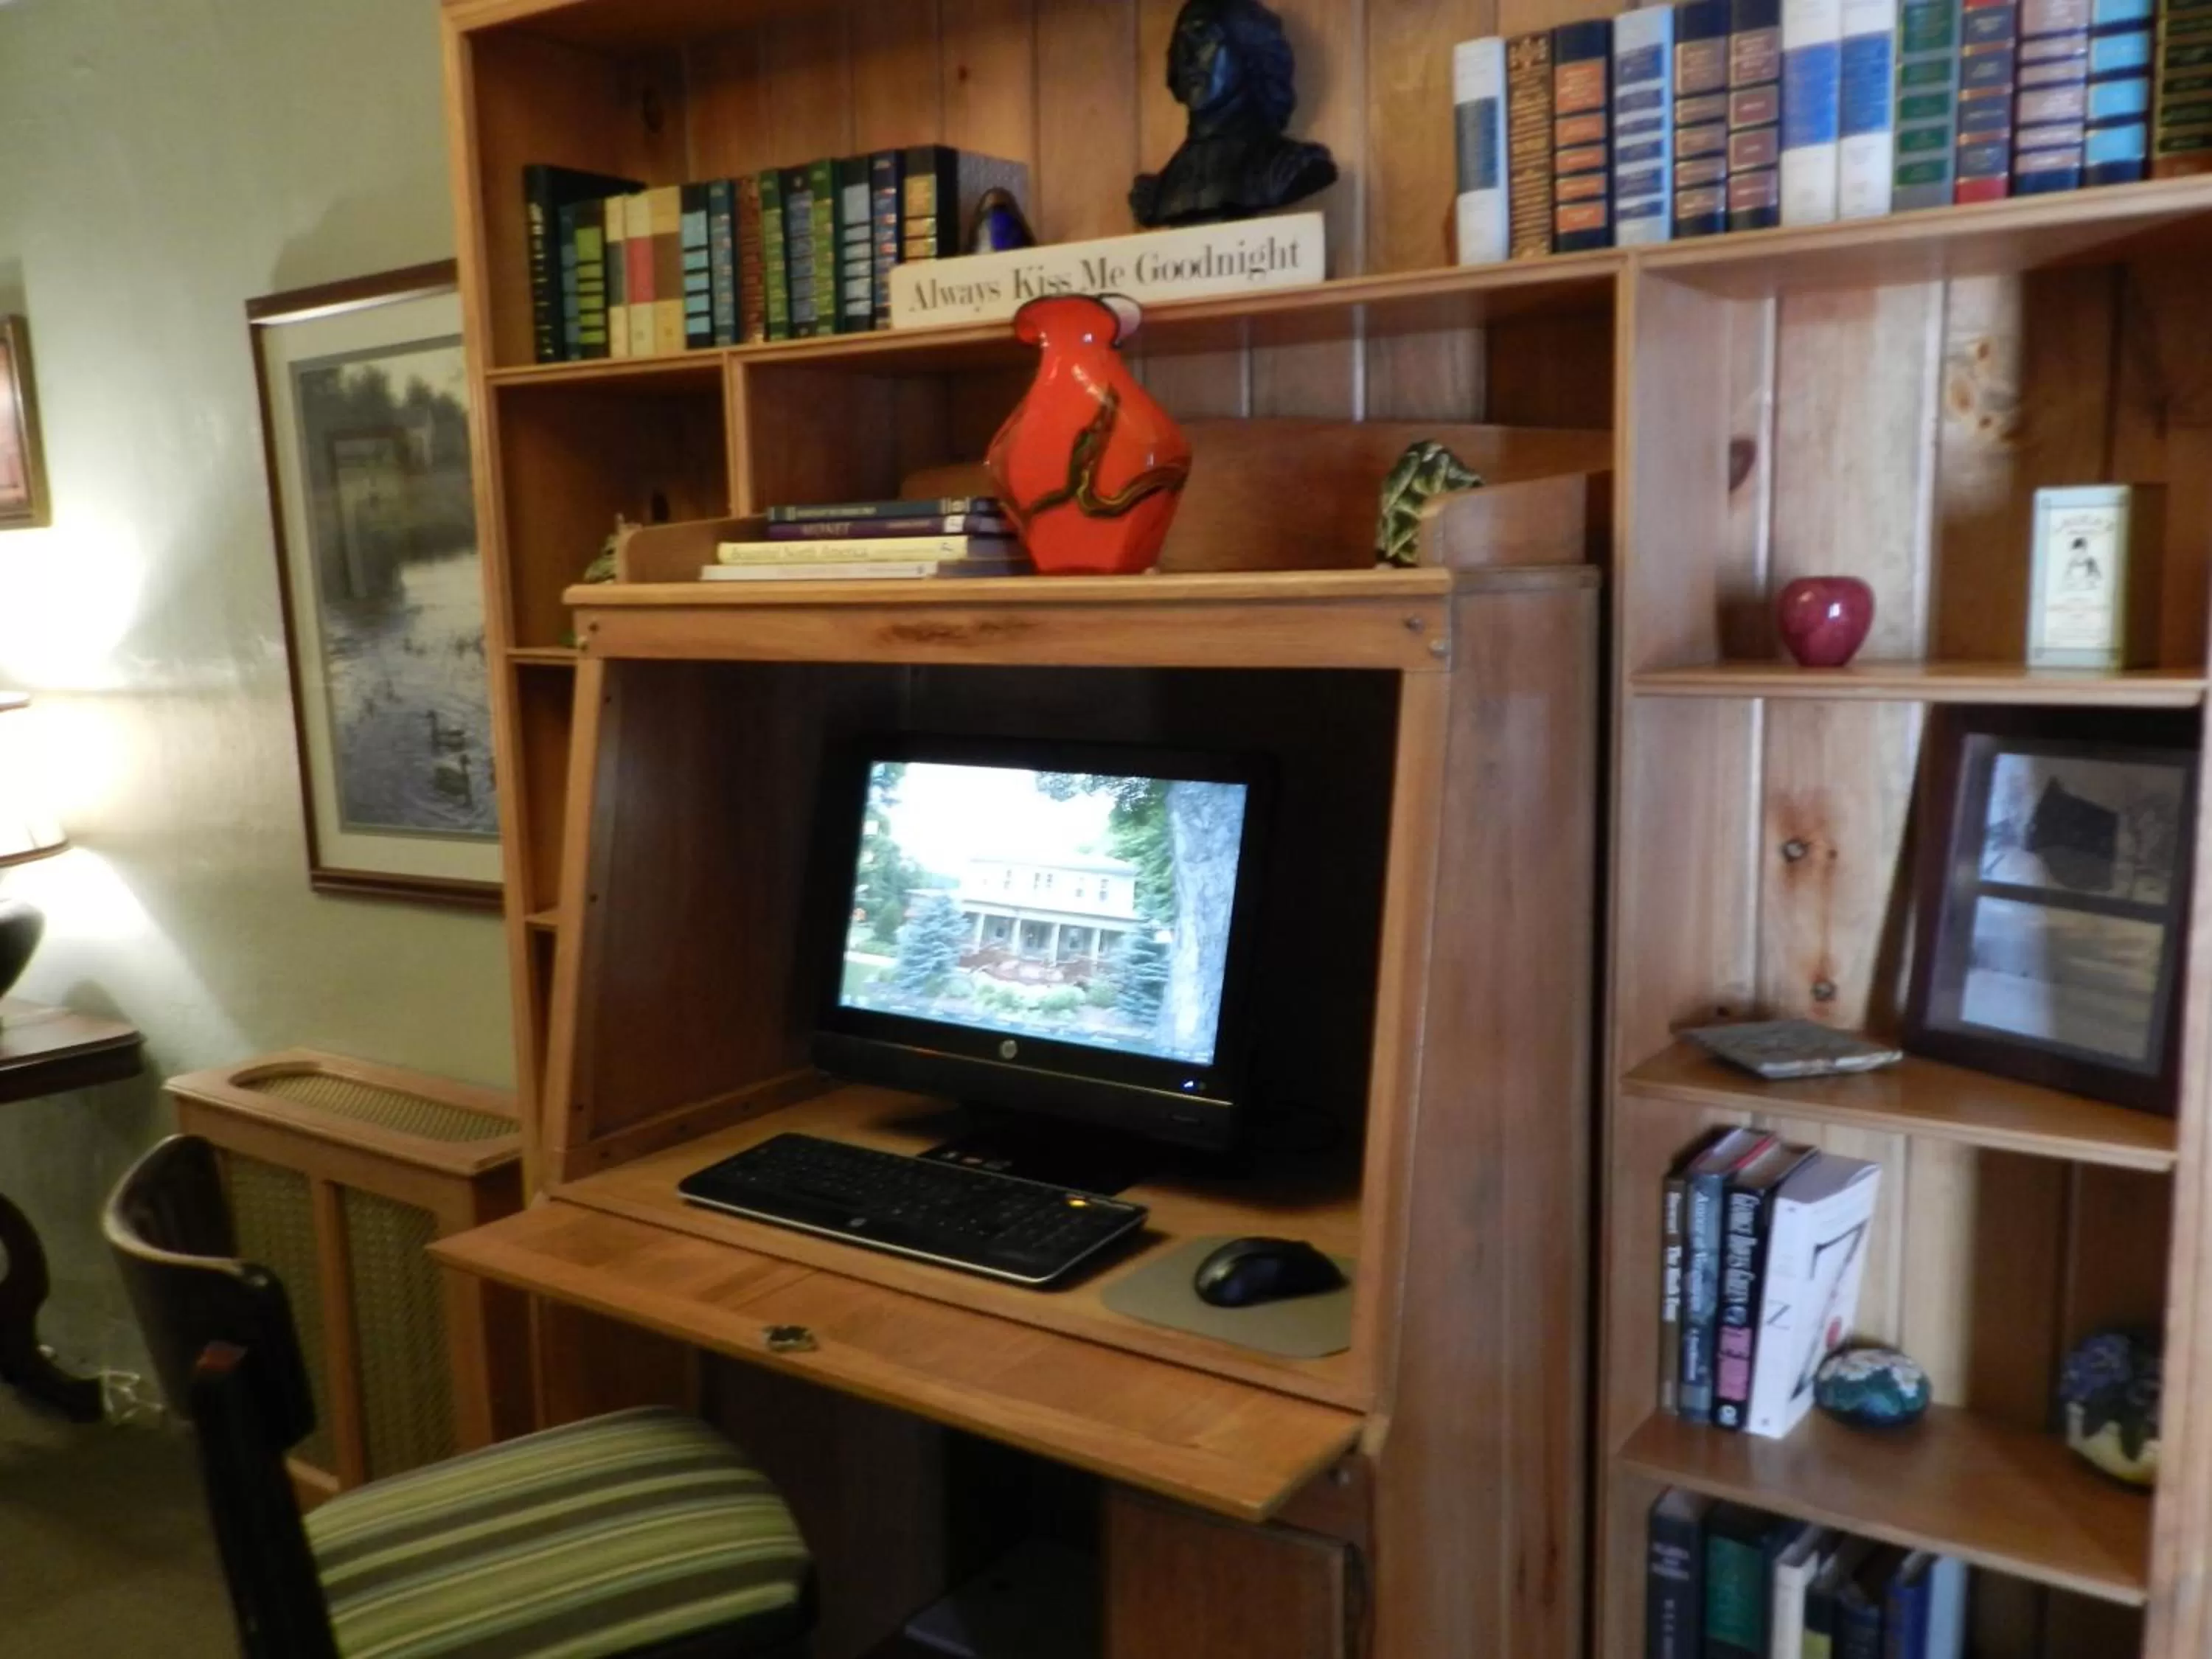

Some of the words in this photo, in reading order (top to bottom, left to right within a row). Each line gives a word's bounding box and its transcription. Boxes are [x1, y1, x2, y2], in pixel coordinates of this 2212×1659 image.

[908, 278, 1001, 313] Always
[1012, 264, 1072, 299] Kiss
[1079, 257, 1125, 290] Me
[1135, 235, 1299, 286] Goodnight
